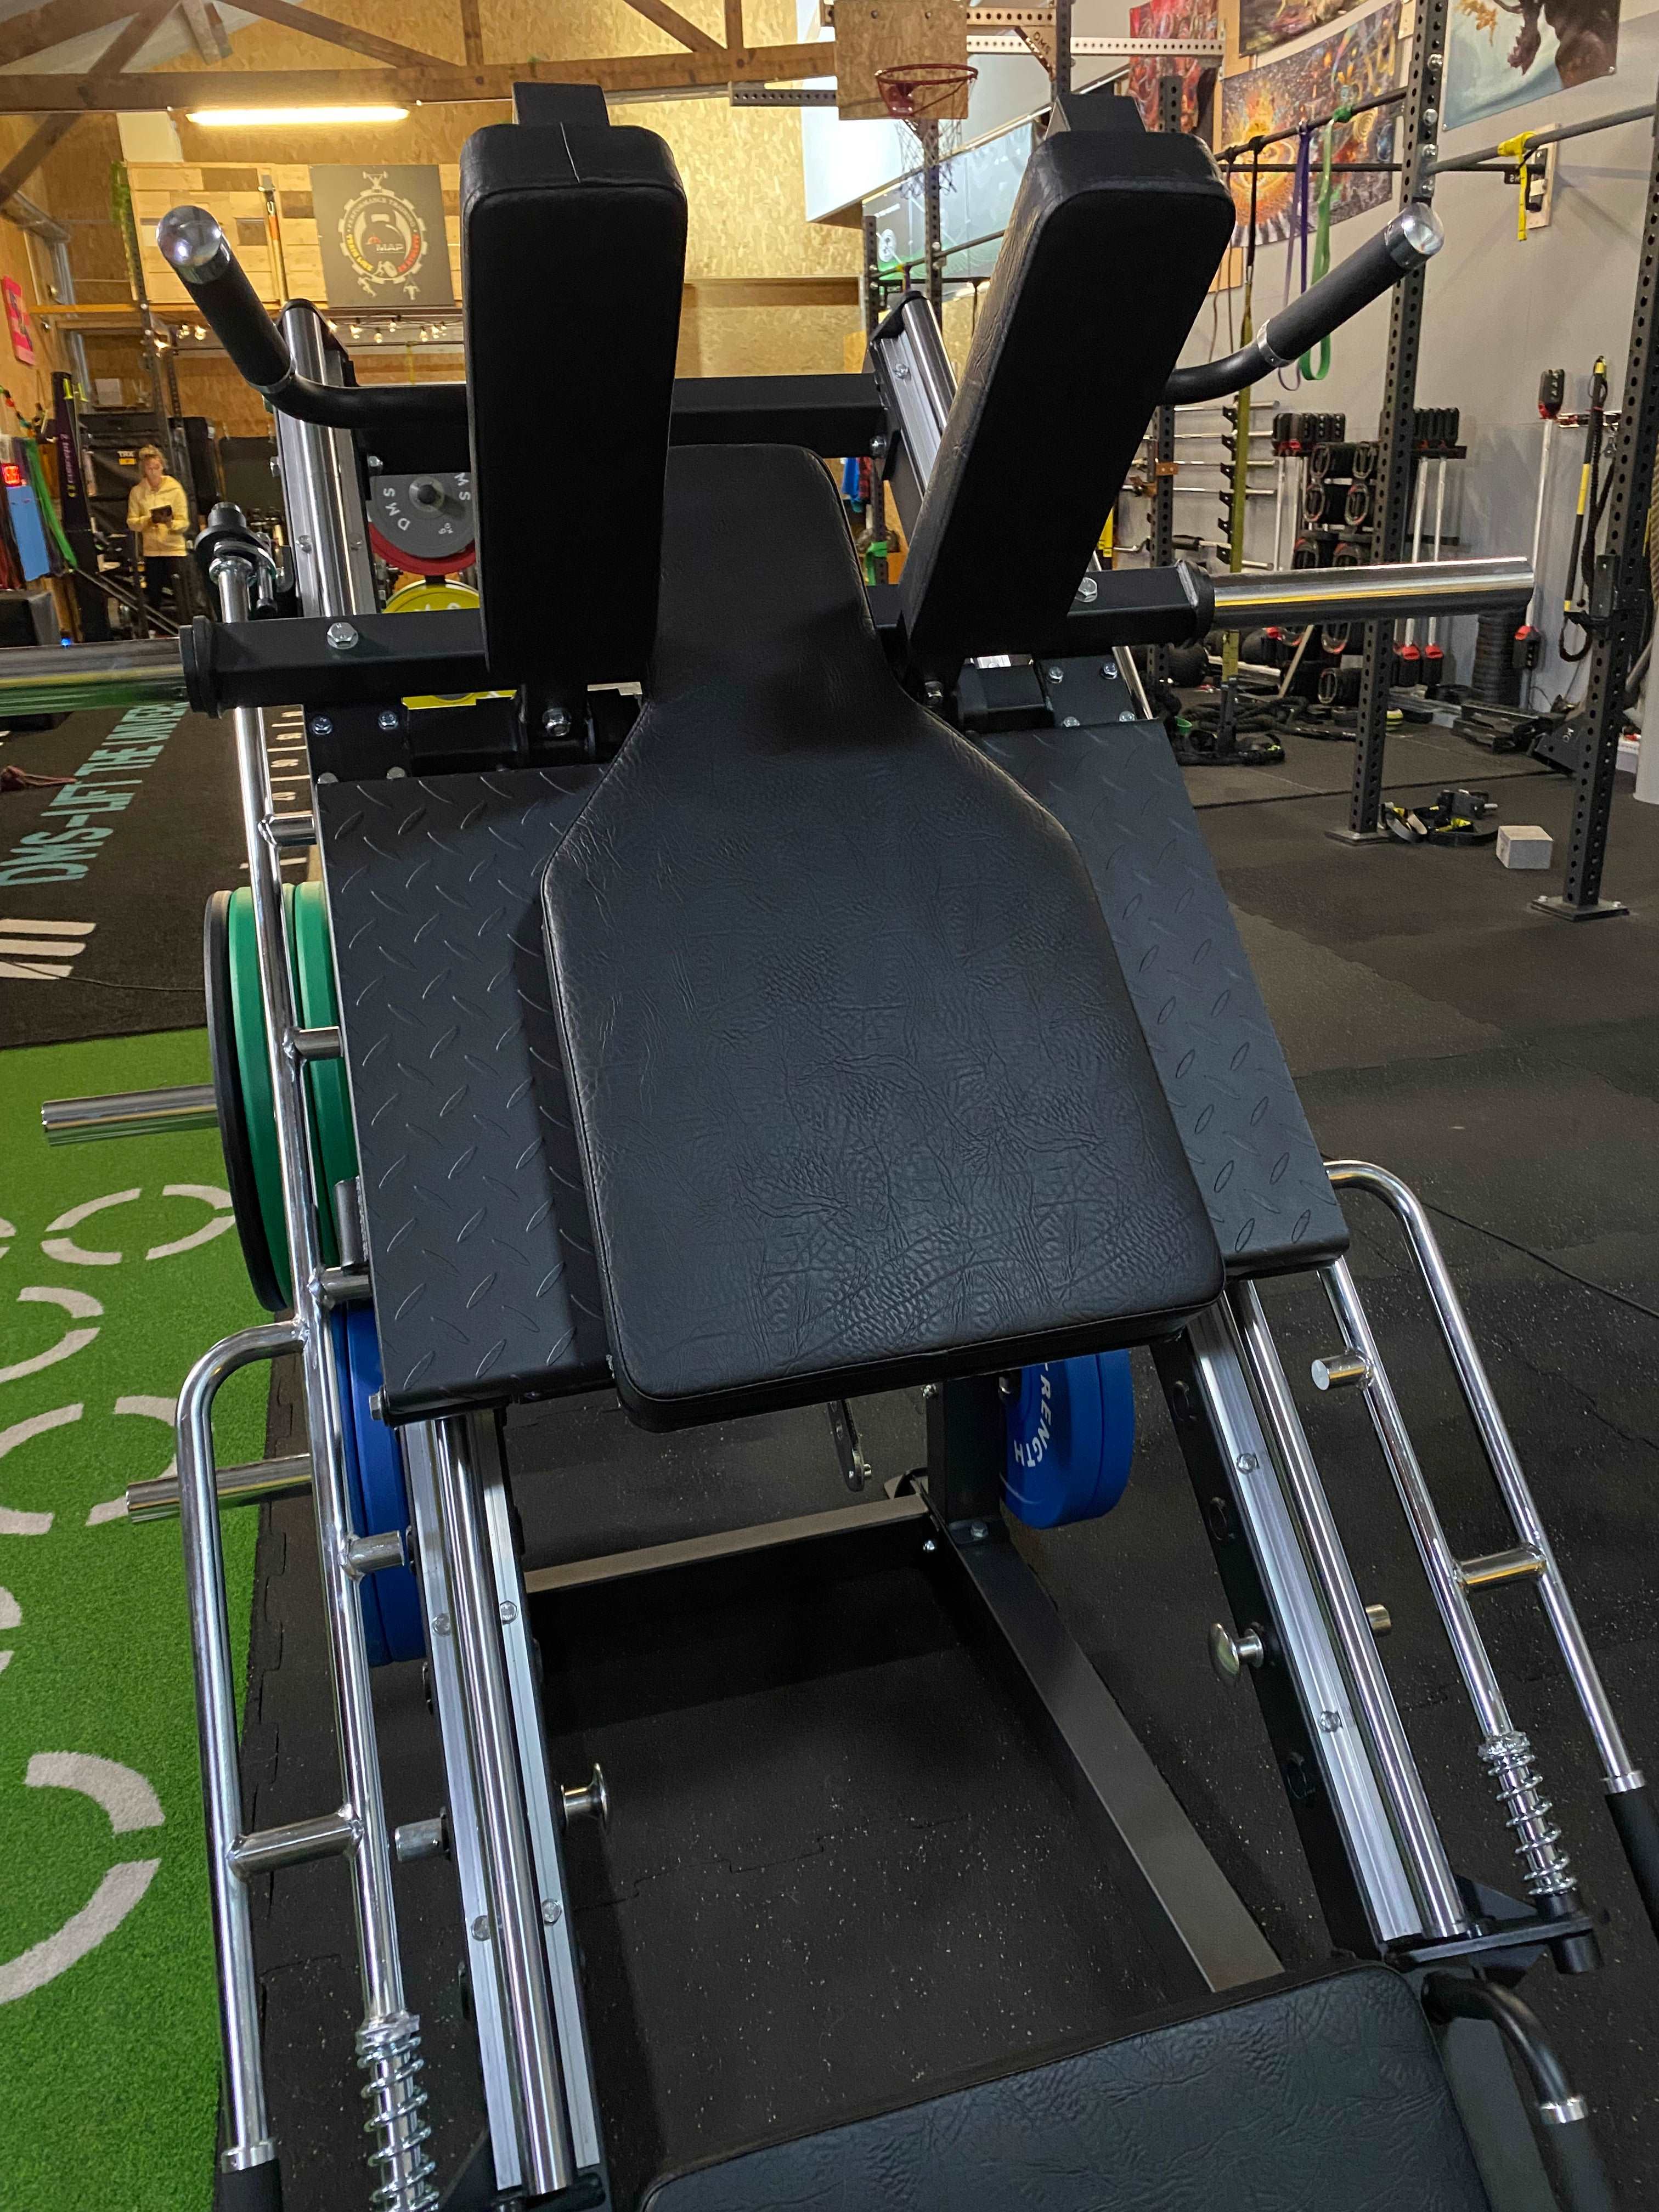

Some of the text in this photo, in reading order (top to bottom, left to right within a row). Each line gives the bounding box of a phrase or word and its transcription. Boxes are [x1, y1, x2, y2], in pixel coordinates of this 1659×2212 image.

[376, 243, 404, 251] MAP
[383, 488, 410, 531] DMS
[74, 745, 164, 777] THE
